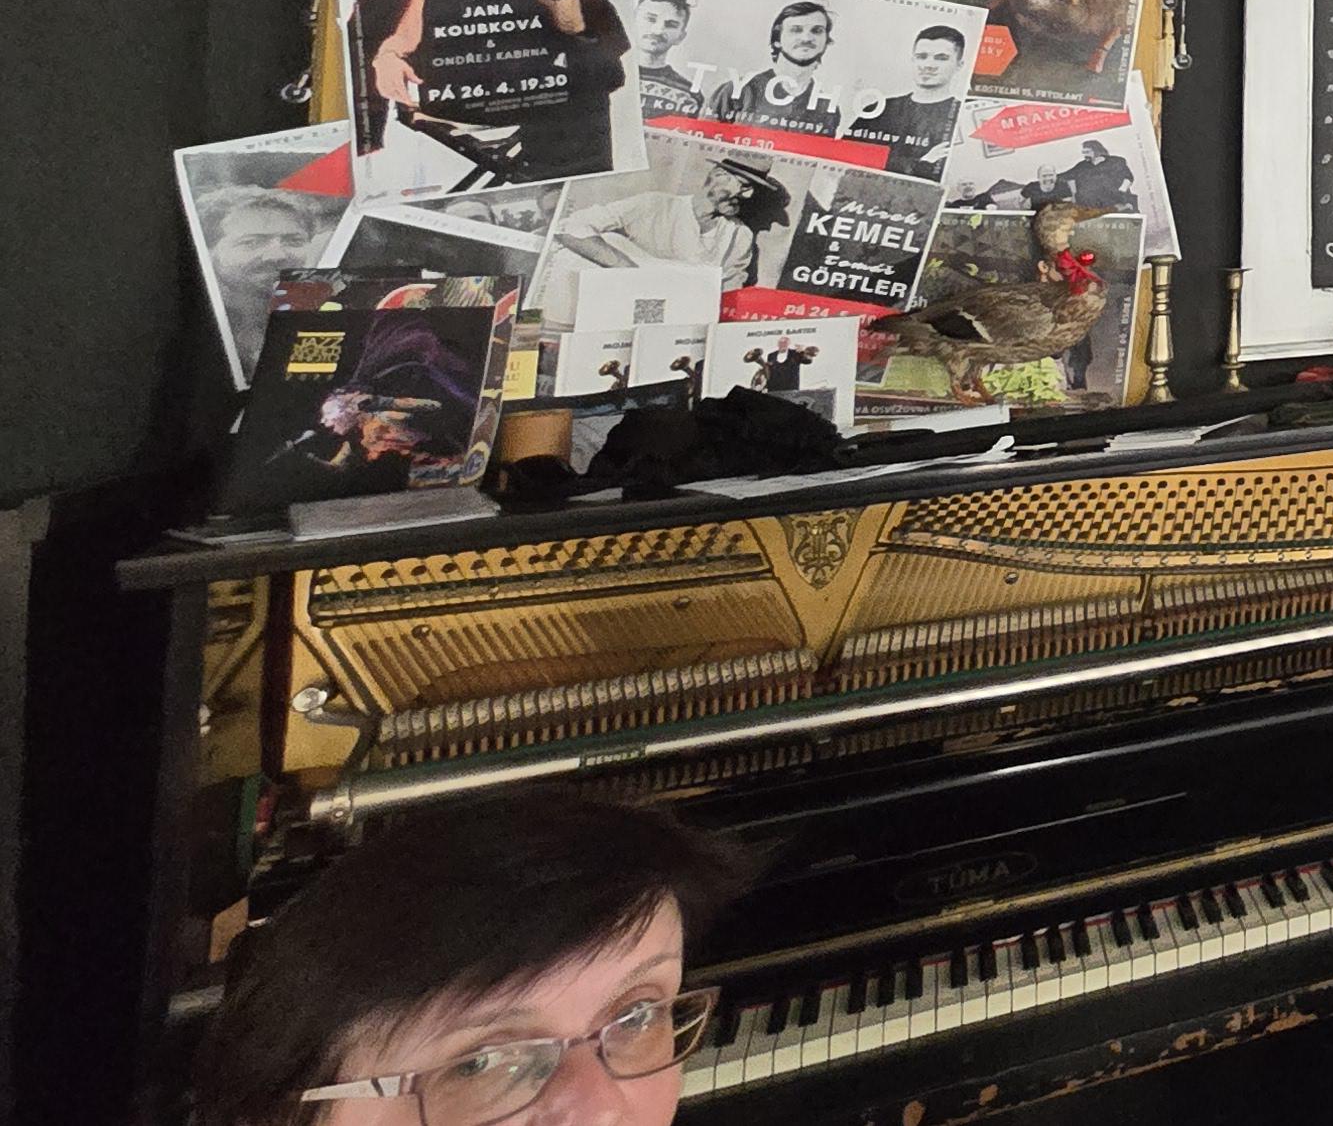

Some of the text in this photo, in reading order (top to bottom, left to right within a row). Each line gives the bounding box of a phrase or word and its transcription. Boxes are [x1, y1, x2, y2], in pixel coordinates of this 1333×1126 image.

[462, 3, 514, 18] JANA
[434, 15, 543, 39] KOUBKOVÁ
[432, 52, 491, 67] ONDŘEJ
[428, 83, 456, 102] PÁ
[461, 84, 491, 99] 26.
[496, 81, 515, 94] 4.
[520, 74, 568, 91] 19.30
[687, 61, 886, 120] TYCHO
[732, 136, 776, 151] 1930
[836, 126, 899, 143] adislav
[805, 212, 920, 253] KEMEL
[792, 265, 909, 299] GÖRTLER
[808, 306, 830, 317] 24
